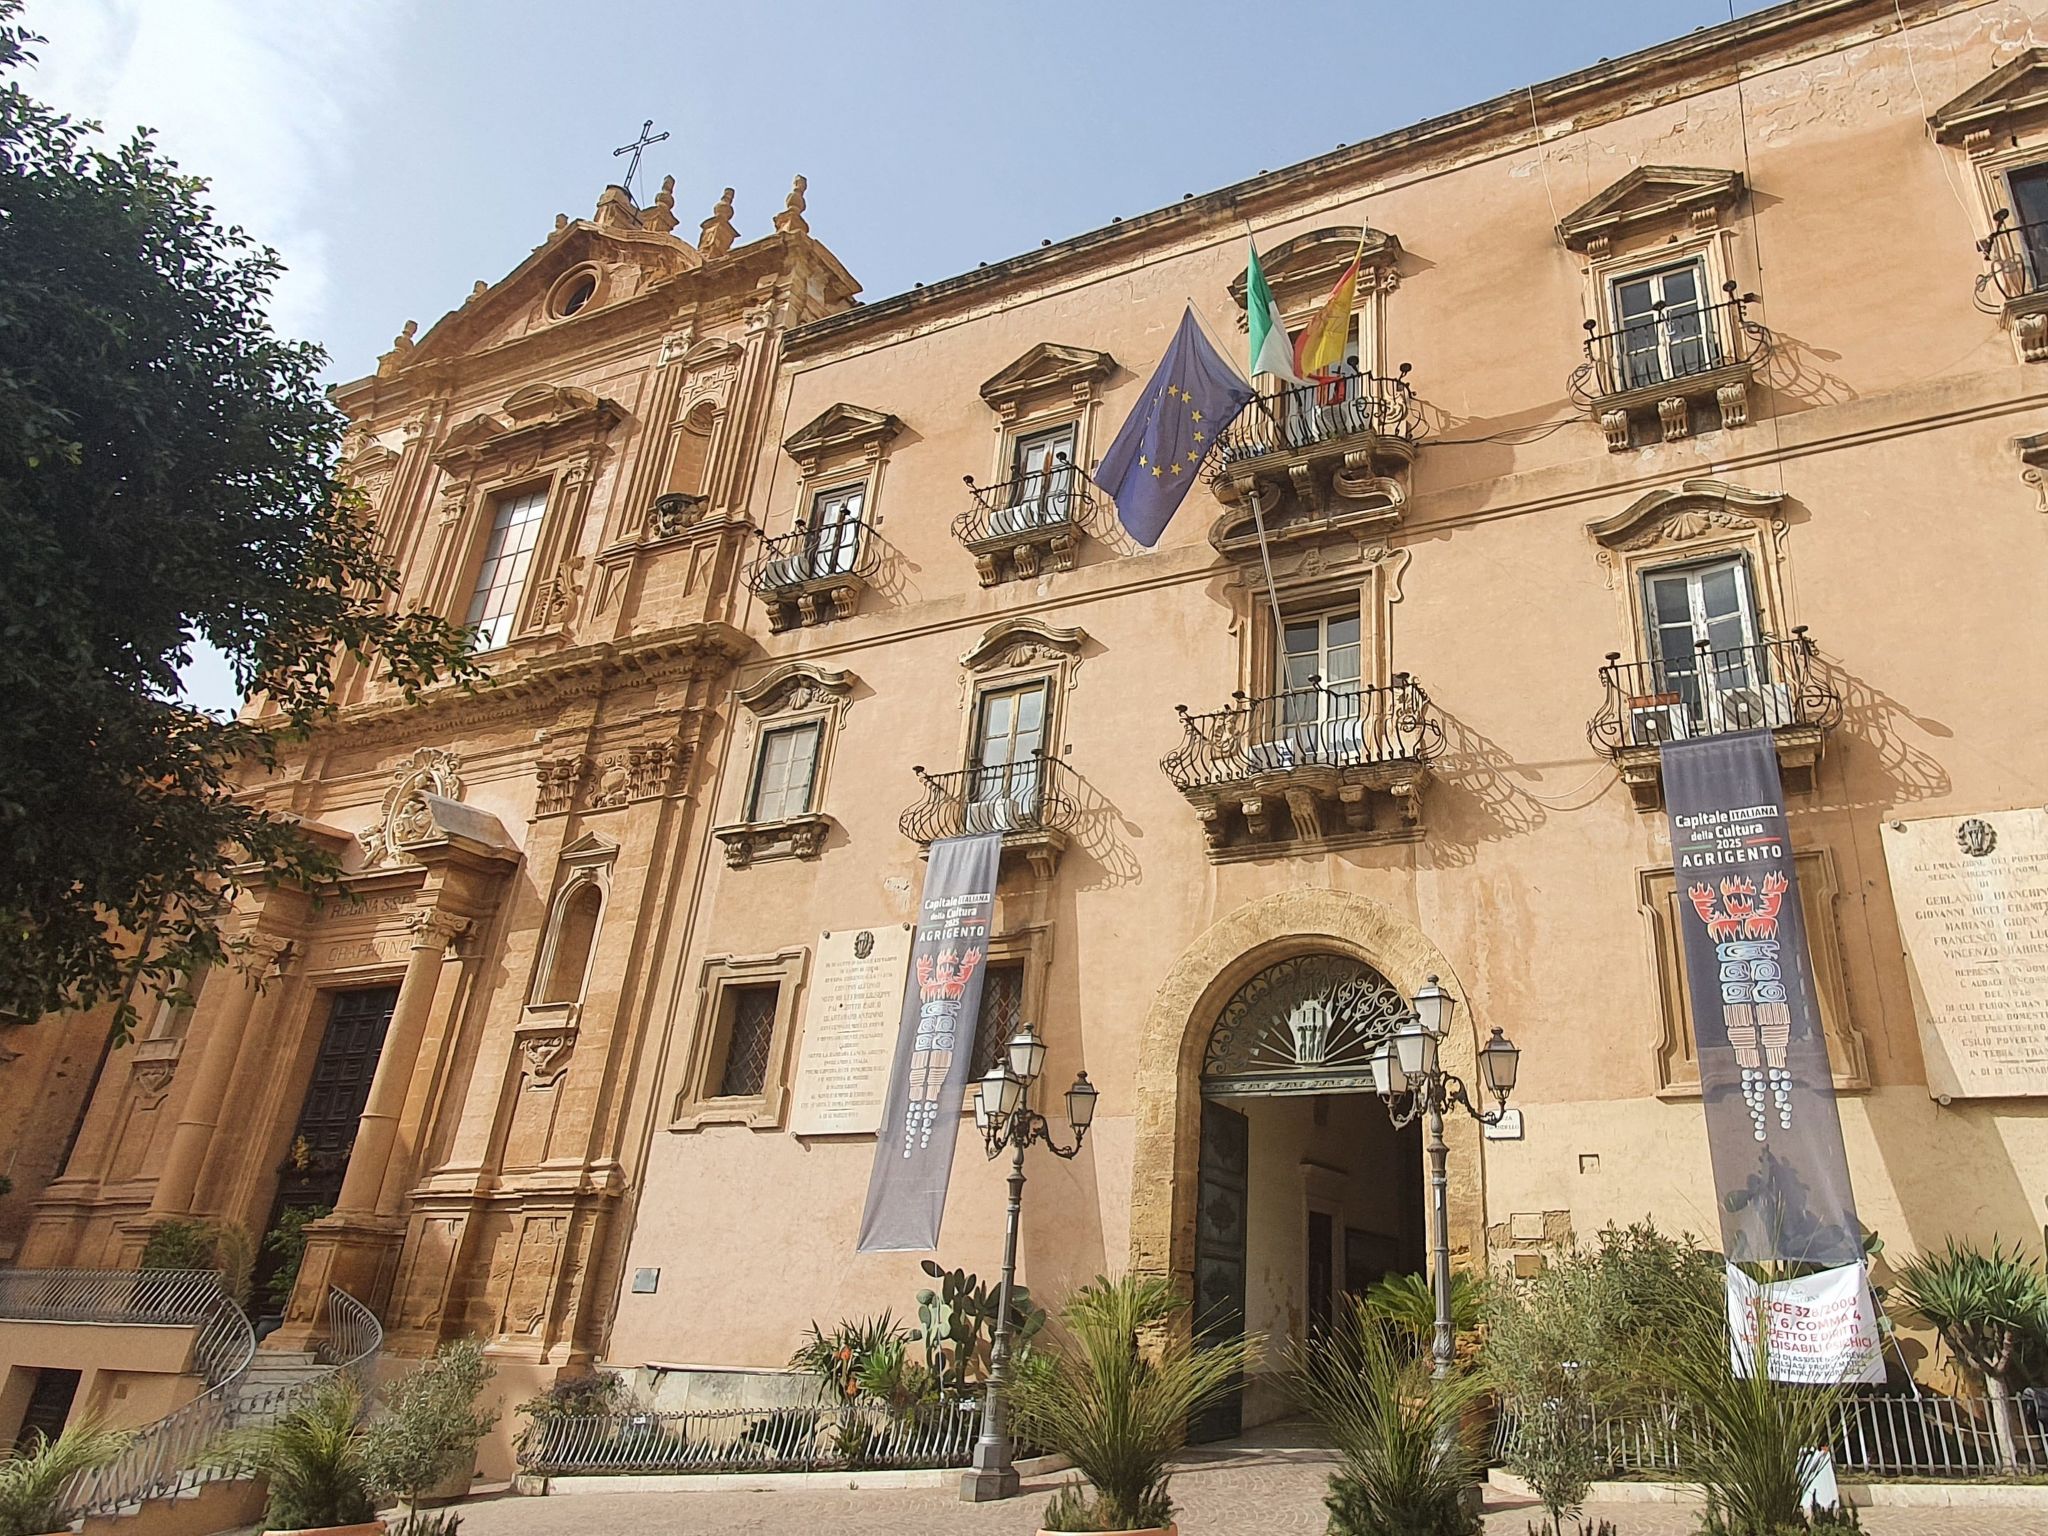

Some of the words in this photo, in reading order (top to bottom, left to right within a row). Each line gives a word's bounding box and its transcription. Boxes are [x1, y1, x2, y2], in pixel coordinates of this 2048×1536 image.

[1675, 810, 1729, 829] Capitale
[1731, 807, 1775, 820] ITALIANA
[1691, 831, 1714, 841] della
[1715, 823, 1764, 838] Cultura
[1716, 838, 1742, 849] 2025
[1682, 845, 1782, 868] AGRIGENTO
[925, 896, 958, 910] Capitale
[961, 894, 989, 903] ITALIANA
[930, 912, 945, 921] della
[946, 907, 977, 919] Cultura
[1915, 908, 1965, 920] GIOVANNI
[944, 918, 960, 928] 2025
[1945, 919, 1994, 932] MARIANO
[920, 926, 985, 942] AGRIGENTO
[1934, 933, 1997, 946] FRANCESCO
[389, 939, 413, 955] NO
[1943, 947, 1998, 959] VINCENZO
[1796, 1313, 1848, 1331] COMMA
[1853, 1310, 1862, 1321] 4
[1811, 1332, 1818, 1341] E
[1770, 1339, 1822, 1353] DISABILI
